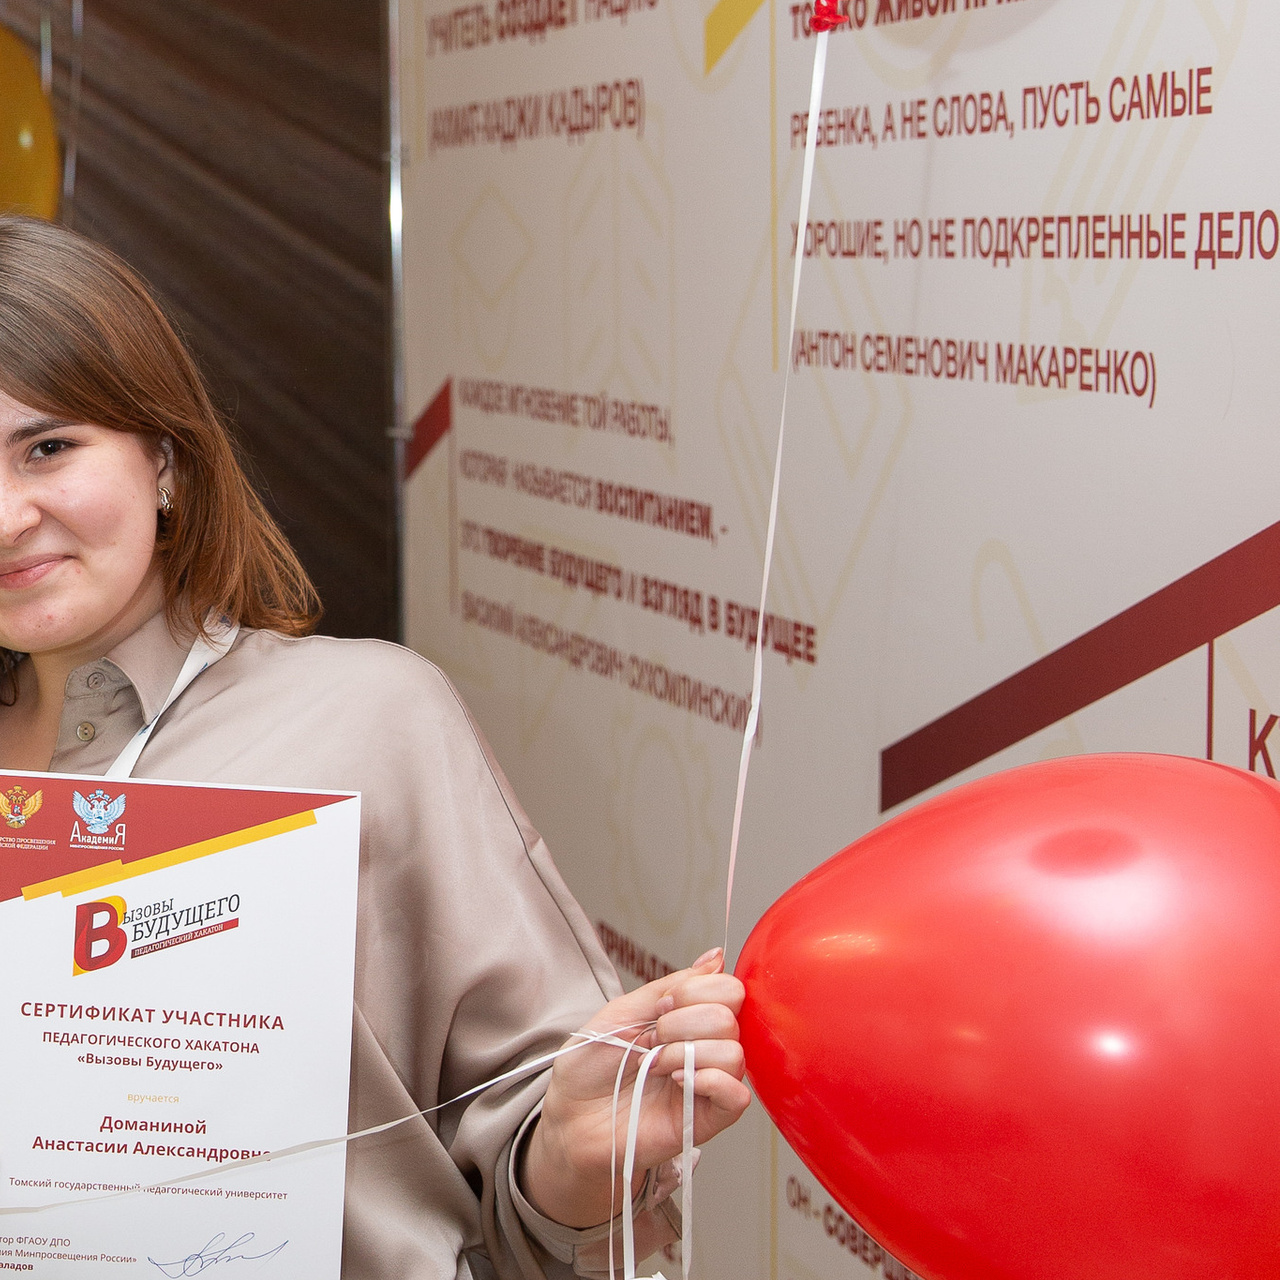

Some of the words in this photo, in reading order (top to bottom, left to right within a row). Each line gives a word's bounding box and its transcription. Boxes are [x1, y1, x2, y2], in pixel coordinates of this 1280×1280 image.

[546, 78, 645, 144] КАДЫРОВ)
[882, 104, 896, 139] А
[902, 100, 927, 138] НЕ
[933, 91, 1015, 138] СЛОВА,
[1022, 81, 1100, 130] ПУСТЬ
[1108, 67, 1213, 122] САМЫЕ
[895, 219, 921, 258] НО
[929, 219, 956, 258] НЕ
[963, 213, 1187, 268] ПОДКРЕПЛЕННЫЕ
[791, 329, 857, 373] (АНТОН
[860, 333, 989, 384] СЕМЕНОВИЧ
[995, 342, 1156, 409] МАКАРЕНКО)
[641, 575, 705, 636] ВЗГЛЯД
[708, 595, 719, 633] В
[132, 894, 240, 942] БУДУЩЕГО
[134, 932, 193, 956] ПЕДАГОГИЧЕСКИЙ
[194, 924, 223, 939] ХАКАТОН
[21, 1001, 155, 1023] СЕРТИФИКАТ
[161, 1009, 285, 1030] УЧАСТНИКА
[43, 1031, 181, 1050] ПЕДАГОГИЧЕСКОГО
[185, 1039, 260, 1053] ХАКАТОНА
[78, 1053, 142, 1066] «Вызовы
[146, 1056, 223, 1071] Будущего»
[127, 1093, 179, 1104] вручается
[100, 1116, 207, 1134] Доманиной
[32, 1136, 128, 1154] Анастасии
[9, 1177, 52, 1188] Томский
[225, 1188, 288, 1200] университет
[16, 1236, 48, 1246] ФГАОУ
[50, 1237, 71, 1248] ДПО
[15, 1249, 98, 1262] Минпросвещения
[100, 1253, 137, 1264] России»
